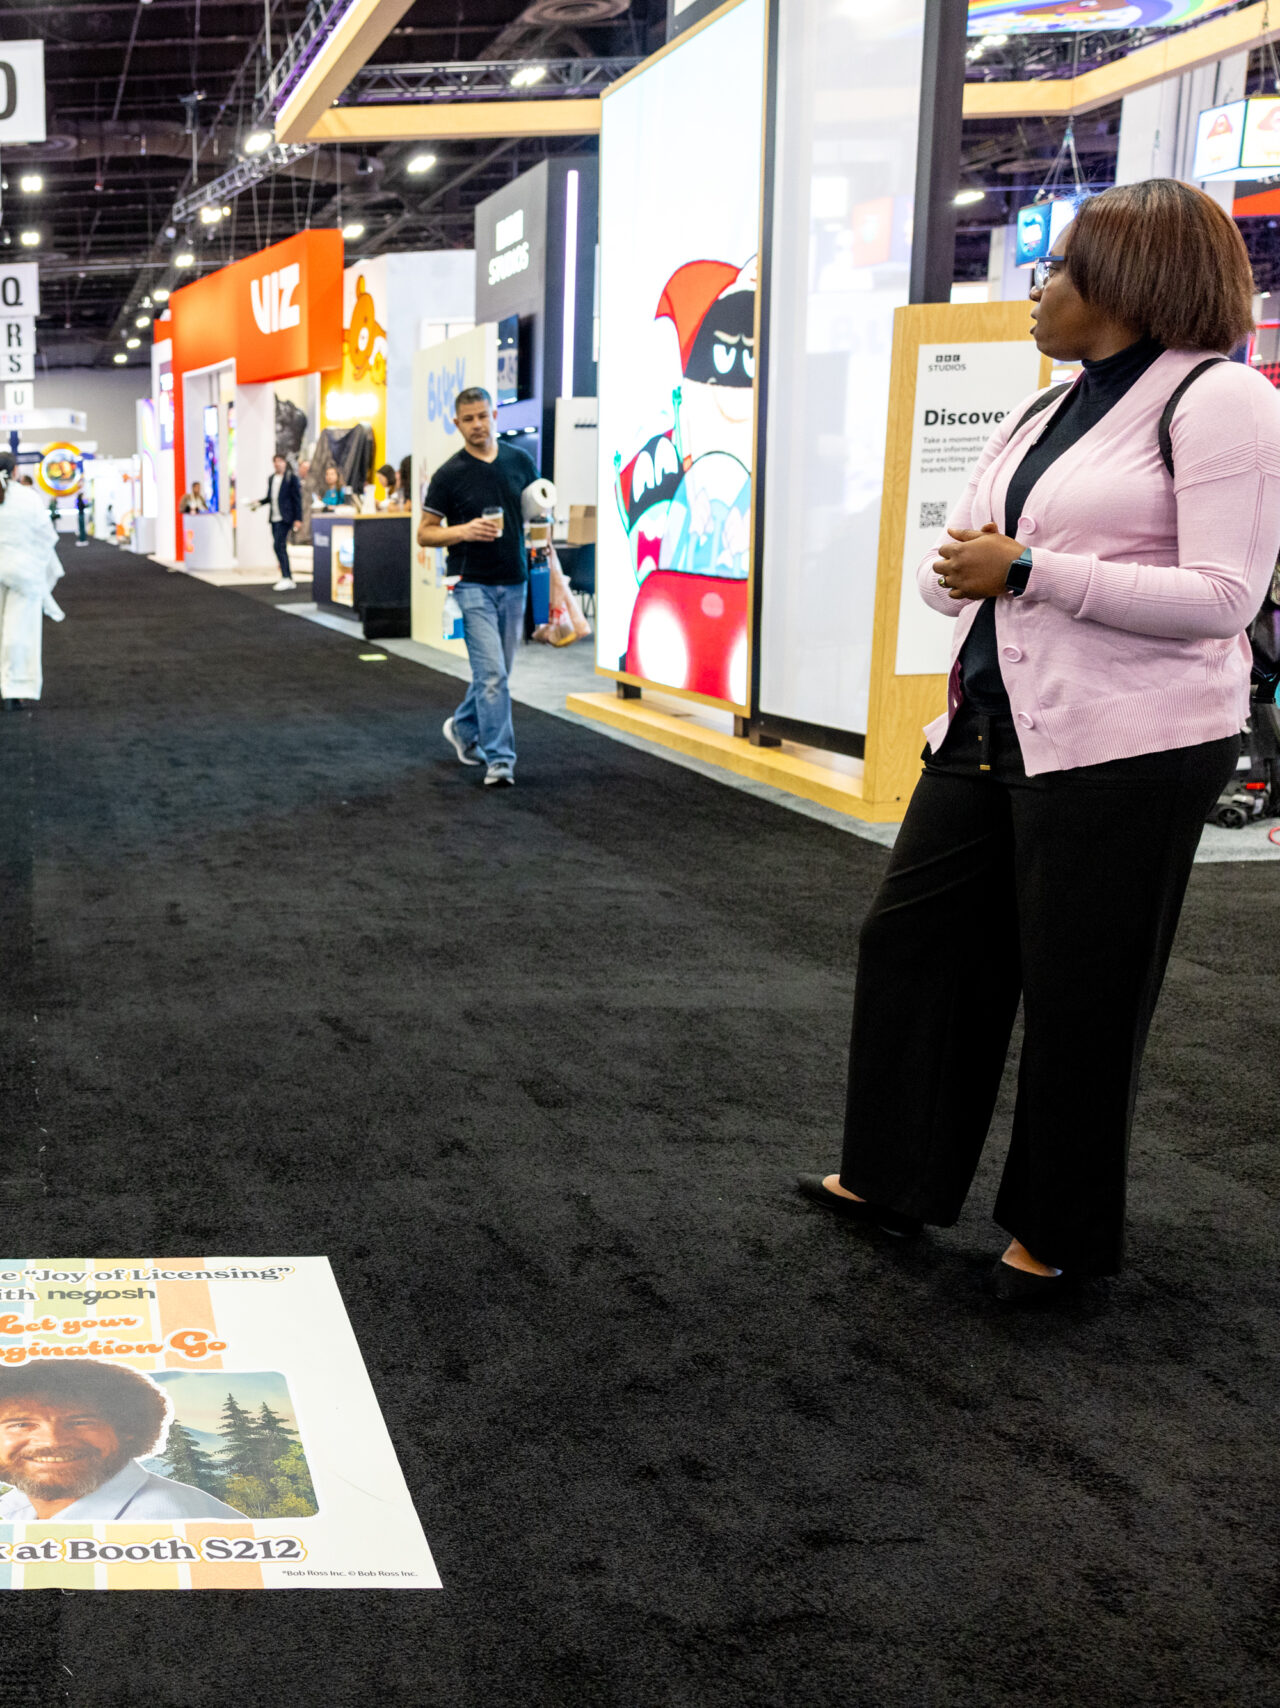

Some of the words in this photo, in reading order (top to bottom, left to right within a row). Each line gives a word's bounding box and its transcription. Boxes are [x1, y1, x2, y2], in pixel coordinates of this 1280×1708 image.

[2, 276, 23, 307] Q
[251, 262, 300, 335] VIZ
[7, 323, 22, 347] R
[9, 354, 21, 373] S
[928, 363, 967, 372] STUDIOS
[14, 391, 24, 405] U
[924, 408, 1010, 426] Discove
[25, 1269, 87, 1283] “Joy
[94, 1269, 128, 1281] of
[133, 1267, 290, 1281] Licensing”
[48, 1287, 156, 1305] negosh
[62, 1316, 137, 1335] your
[170, 1331, 227, 1358] Go
[16, 1541, 58, 1560] at
[69, 1539, 196, 1560] Booth
[205, 1539, 301, 1560] S212
